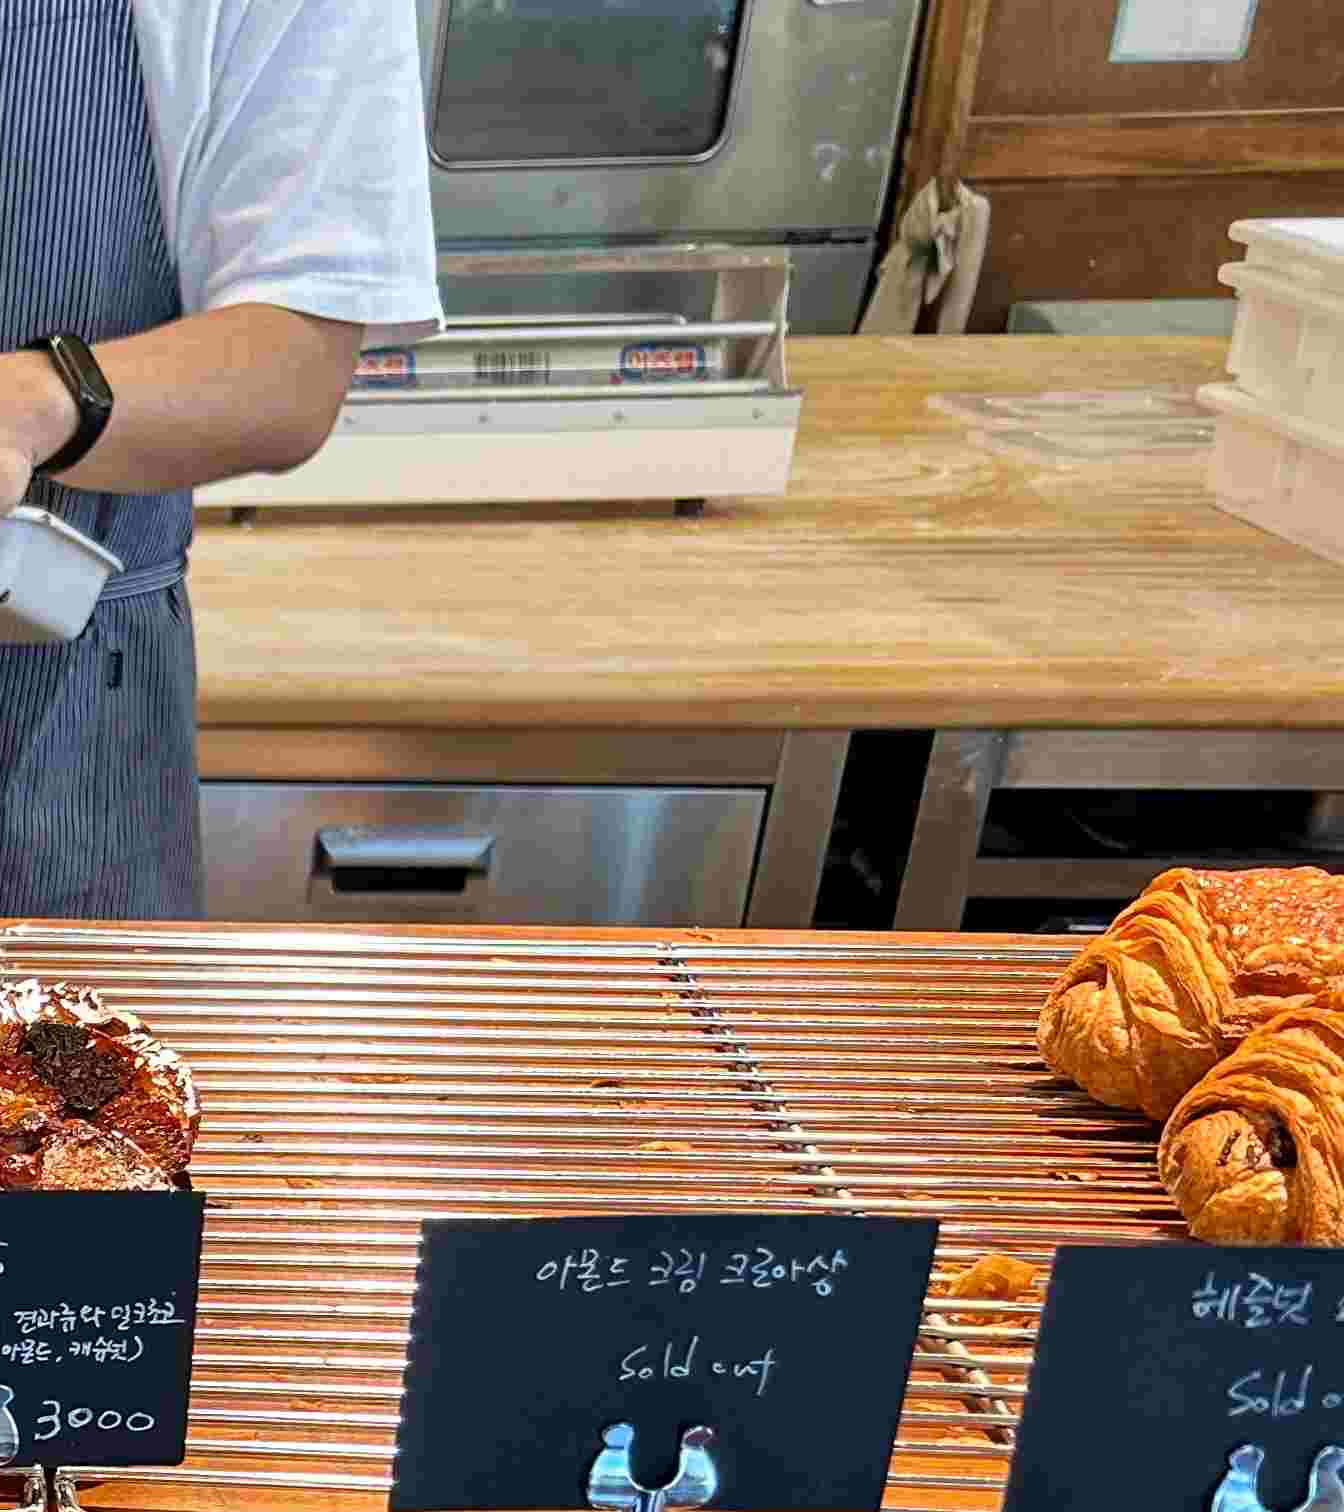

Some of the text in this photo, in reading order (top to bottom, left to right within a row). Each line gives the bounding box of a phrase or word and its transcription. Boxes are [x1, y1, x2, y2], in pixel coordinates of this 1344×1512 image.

[536, 1248, 630, 1292] 아몬드
[648, 1247, 706, 1293] 크림
[13, 1302, 107, 1334] 견과류와
[111, 1297, 186, 1327] 밀크초코
[618, 1335, 776, 1396] Sold out
[1227, 1364, 1313, 1417] Sold
[34, 1399, 155, 1441] 3000
